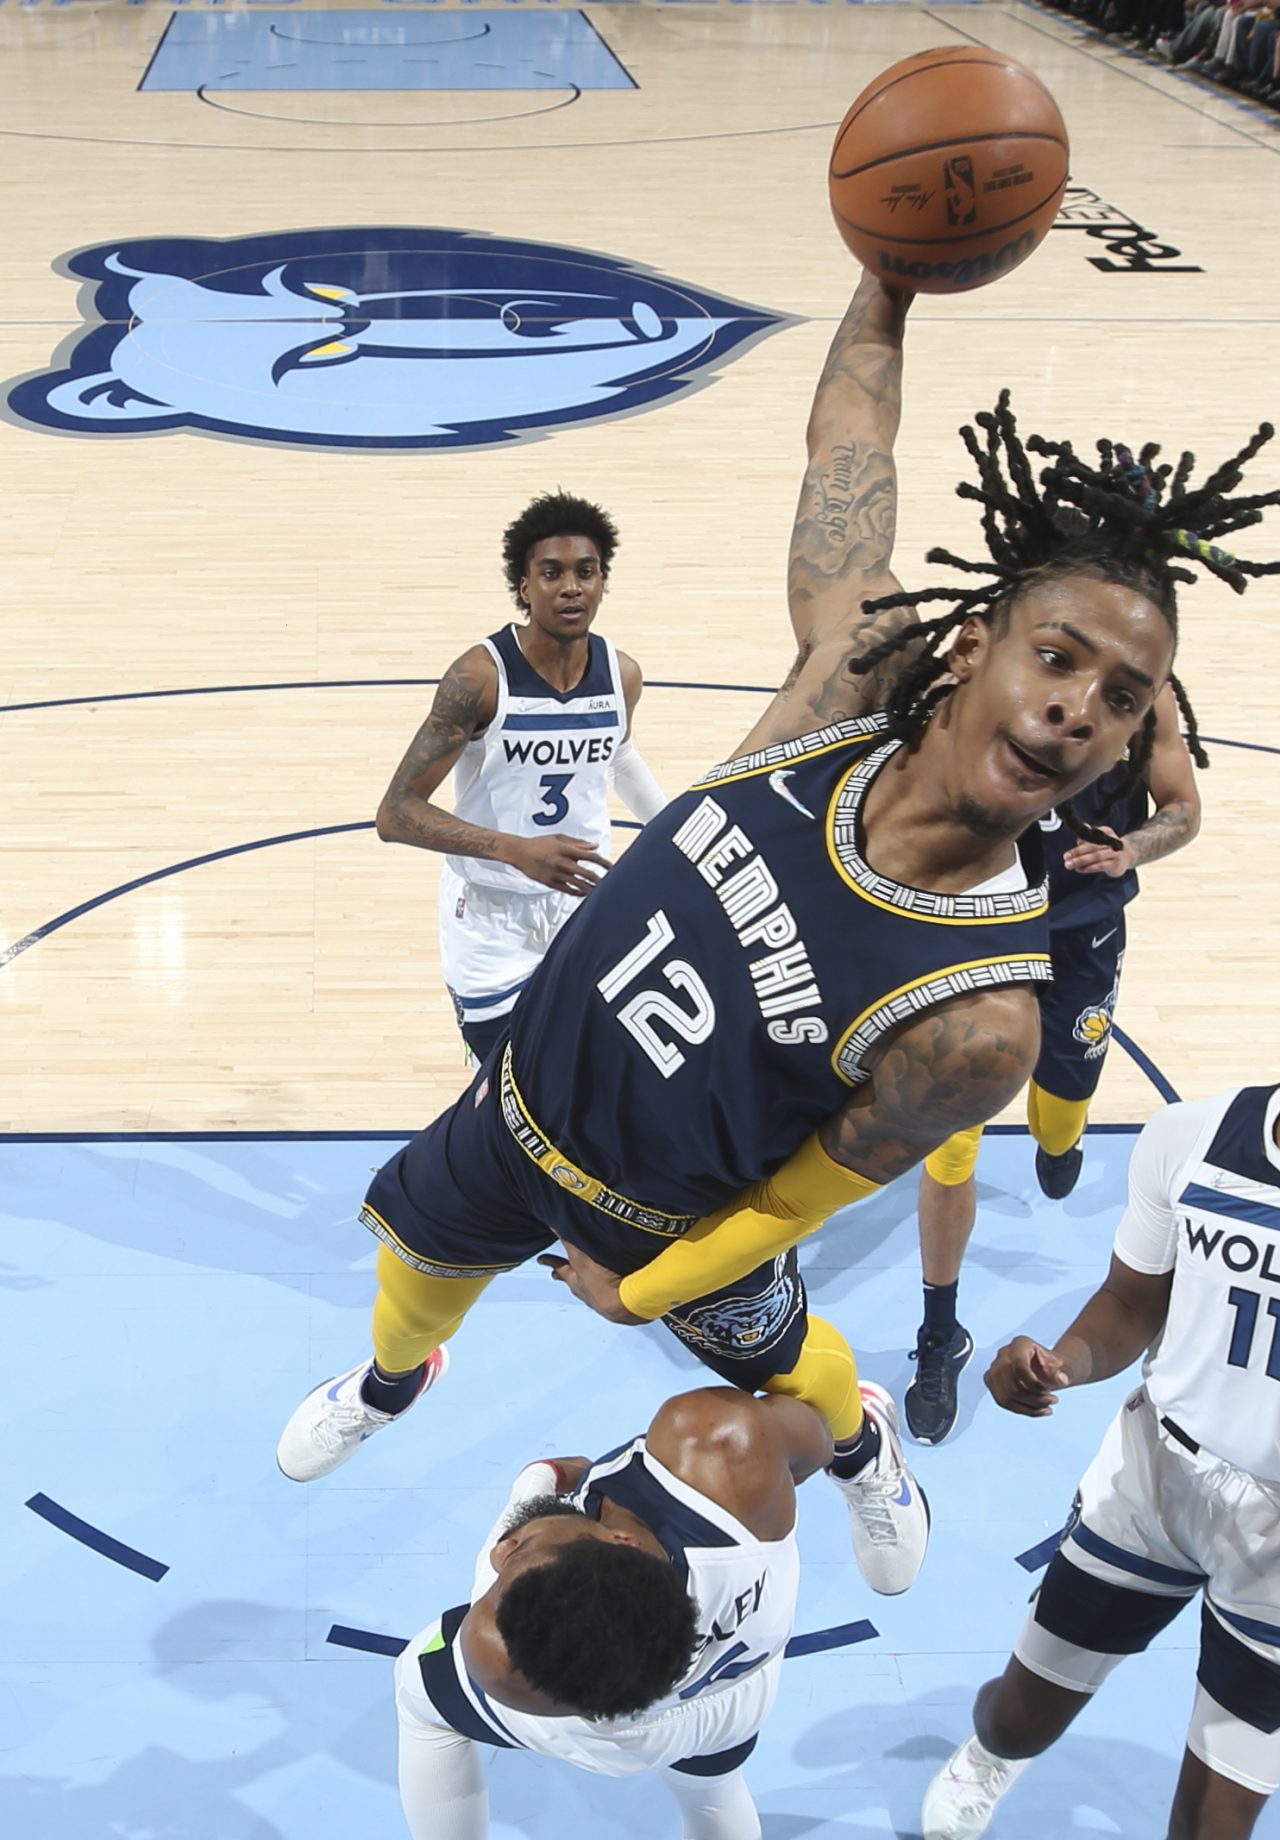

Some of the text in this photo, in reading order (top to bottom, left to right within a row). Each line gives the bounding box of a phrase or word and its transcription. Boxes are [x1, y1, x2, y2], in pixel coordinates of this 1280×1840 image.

[503, 736, 613, 765] WOLVES
[532, 773, 575, 826] 3
[672, 795, 829, 1045] MEMPHIS
[597, 909, 716, 1079] 12
